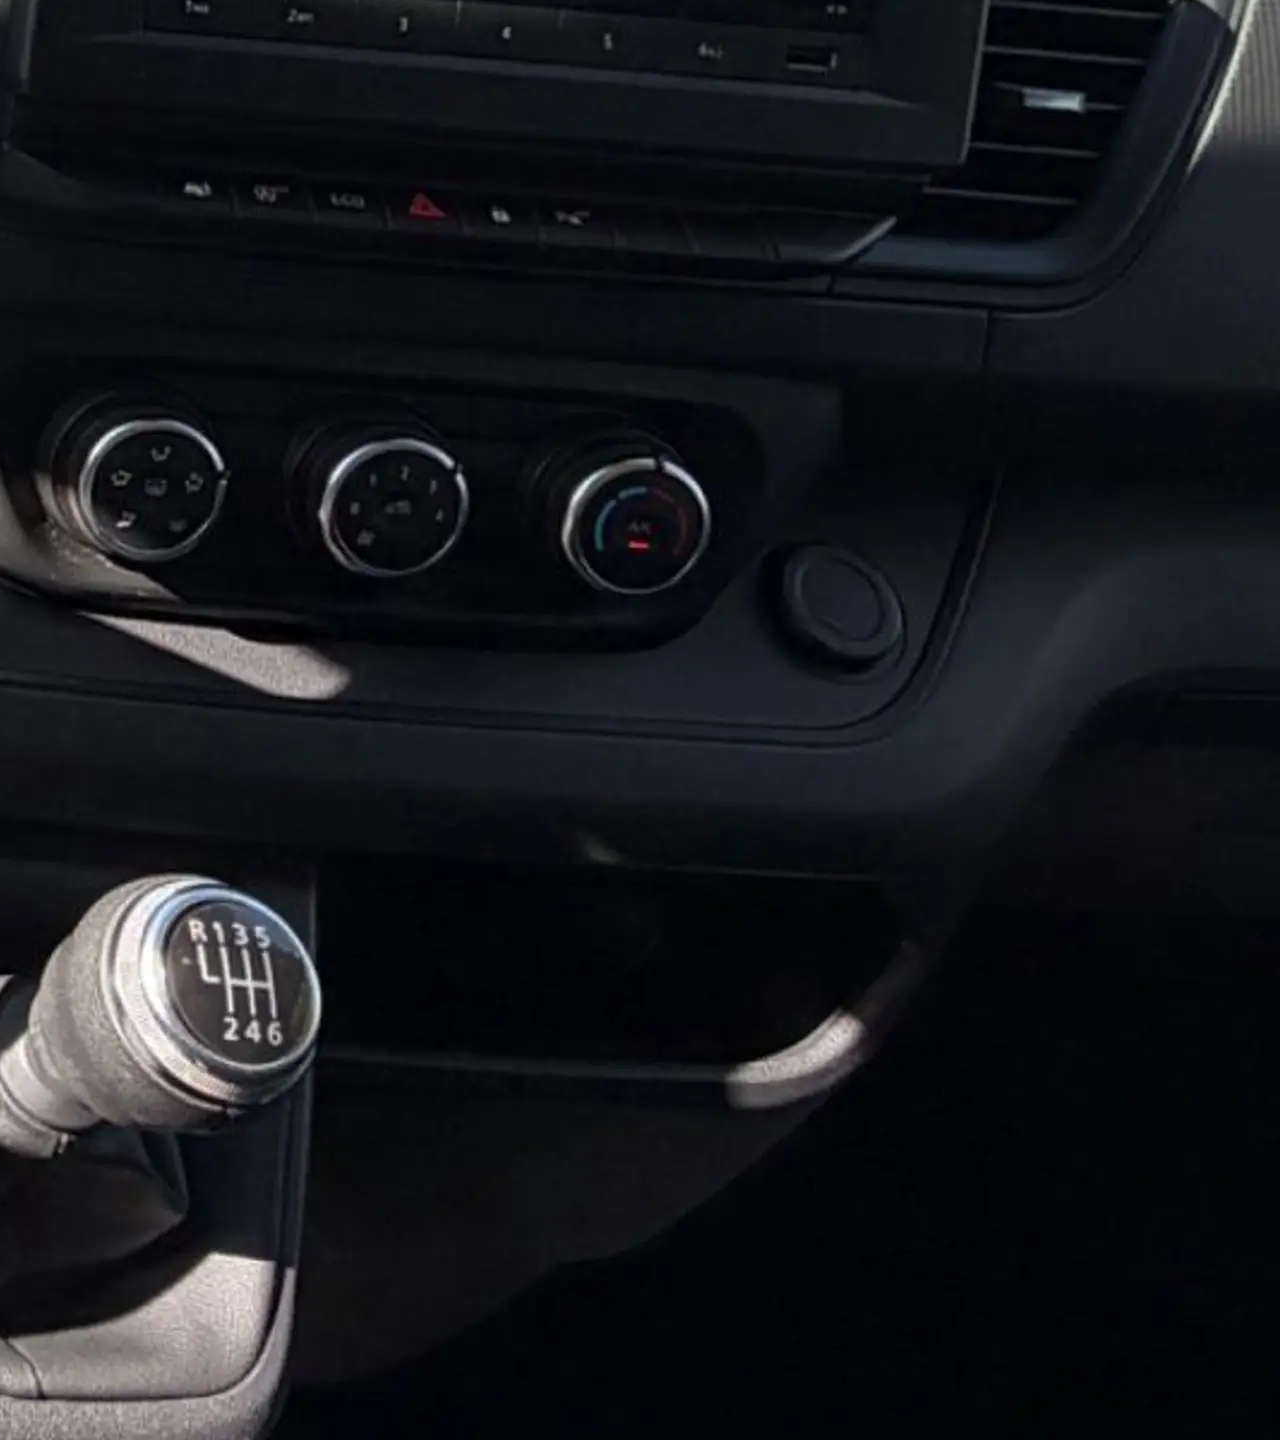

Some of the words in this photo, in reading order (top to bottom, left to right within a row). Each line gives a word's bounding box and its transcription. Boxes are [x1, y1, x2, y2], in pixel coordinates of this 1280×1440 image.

[187, 918, 208, 943] R
[212, 921, 226, 945] 1
[231, 923, 249, 946] 3
[254, 926, 271, 948] 5
[223, 1017, 240, 1042] 2
[244, 1019, 262, 1043] 4
[267, 1021, 283, 1047] 6
